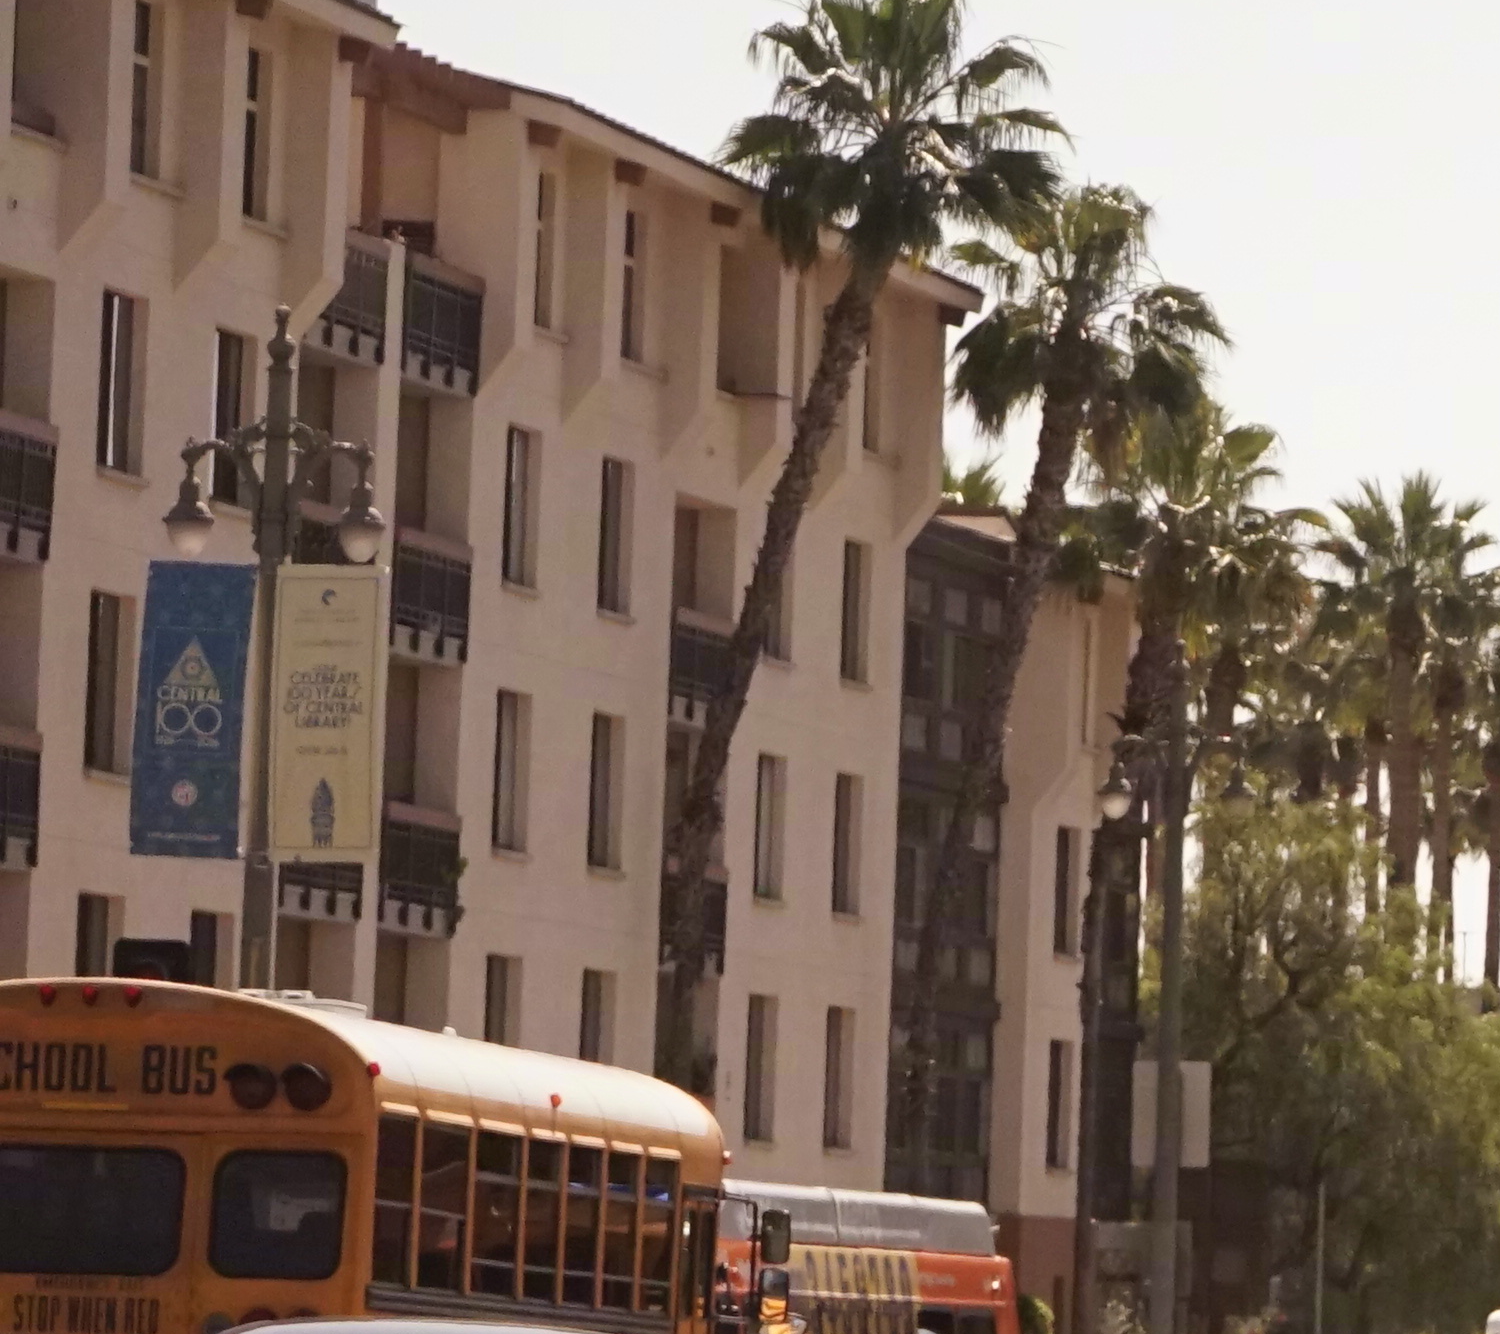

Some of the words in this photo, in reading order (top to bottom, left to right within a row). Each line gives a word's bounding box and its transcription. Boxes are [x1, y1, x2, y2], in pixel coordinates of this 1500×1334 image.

[156, 684, 223, 704] CENTRAL
[155, 701, 223, 735] 100
[0, 1041, 117, 1094] CHOOL
[141, 1043, 218, 1096] BUS
[12, 1293, 61, 1333] STOP
